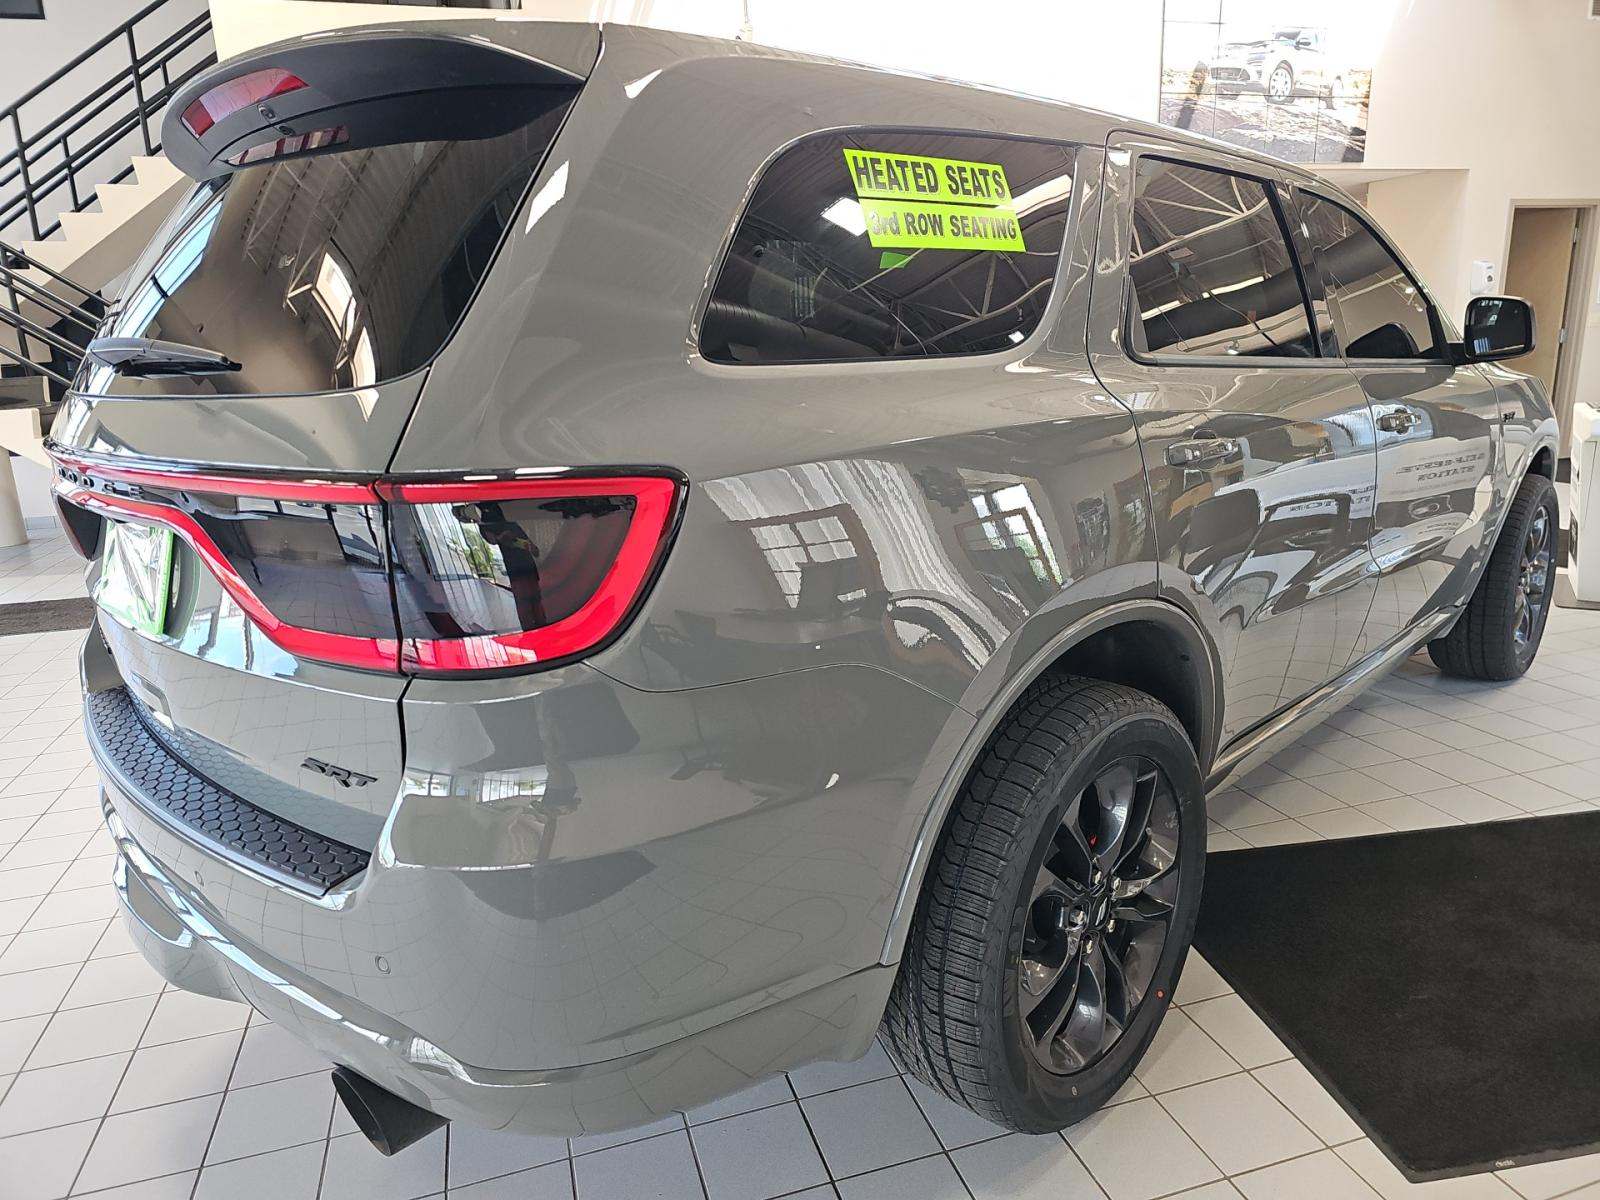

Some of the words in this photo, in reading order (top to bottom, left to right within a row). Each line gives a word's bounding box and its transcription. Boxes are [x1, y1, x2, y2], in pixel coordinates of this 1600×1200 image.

[852, 155, 939, 194] HEATED
[945, 164, 1007, 199] SEATS
[868, 211, 900, 236] 3rd
[903, 212, 945, 238] ROW
[949, 214, 1017, 240] SEATING
[300, 757, 379, 789] SRT
